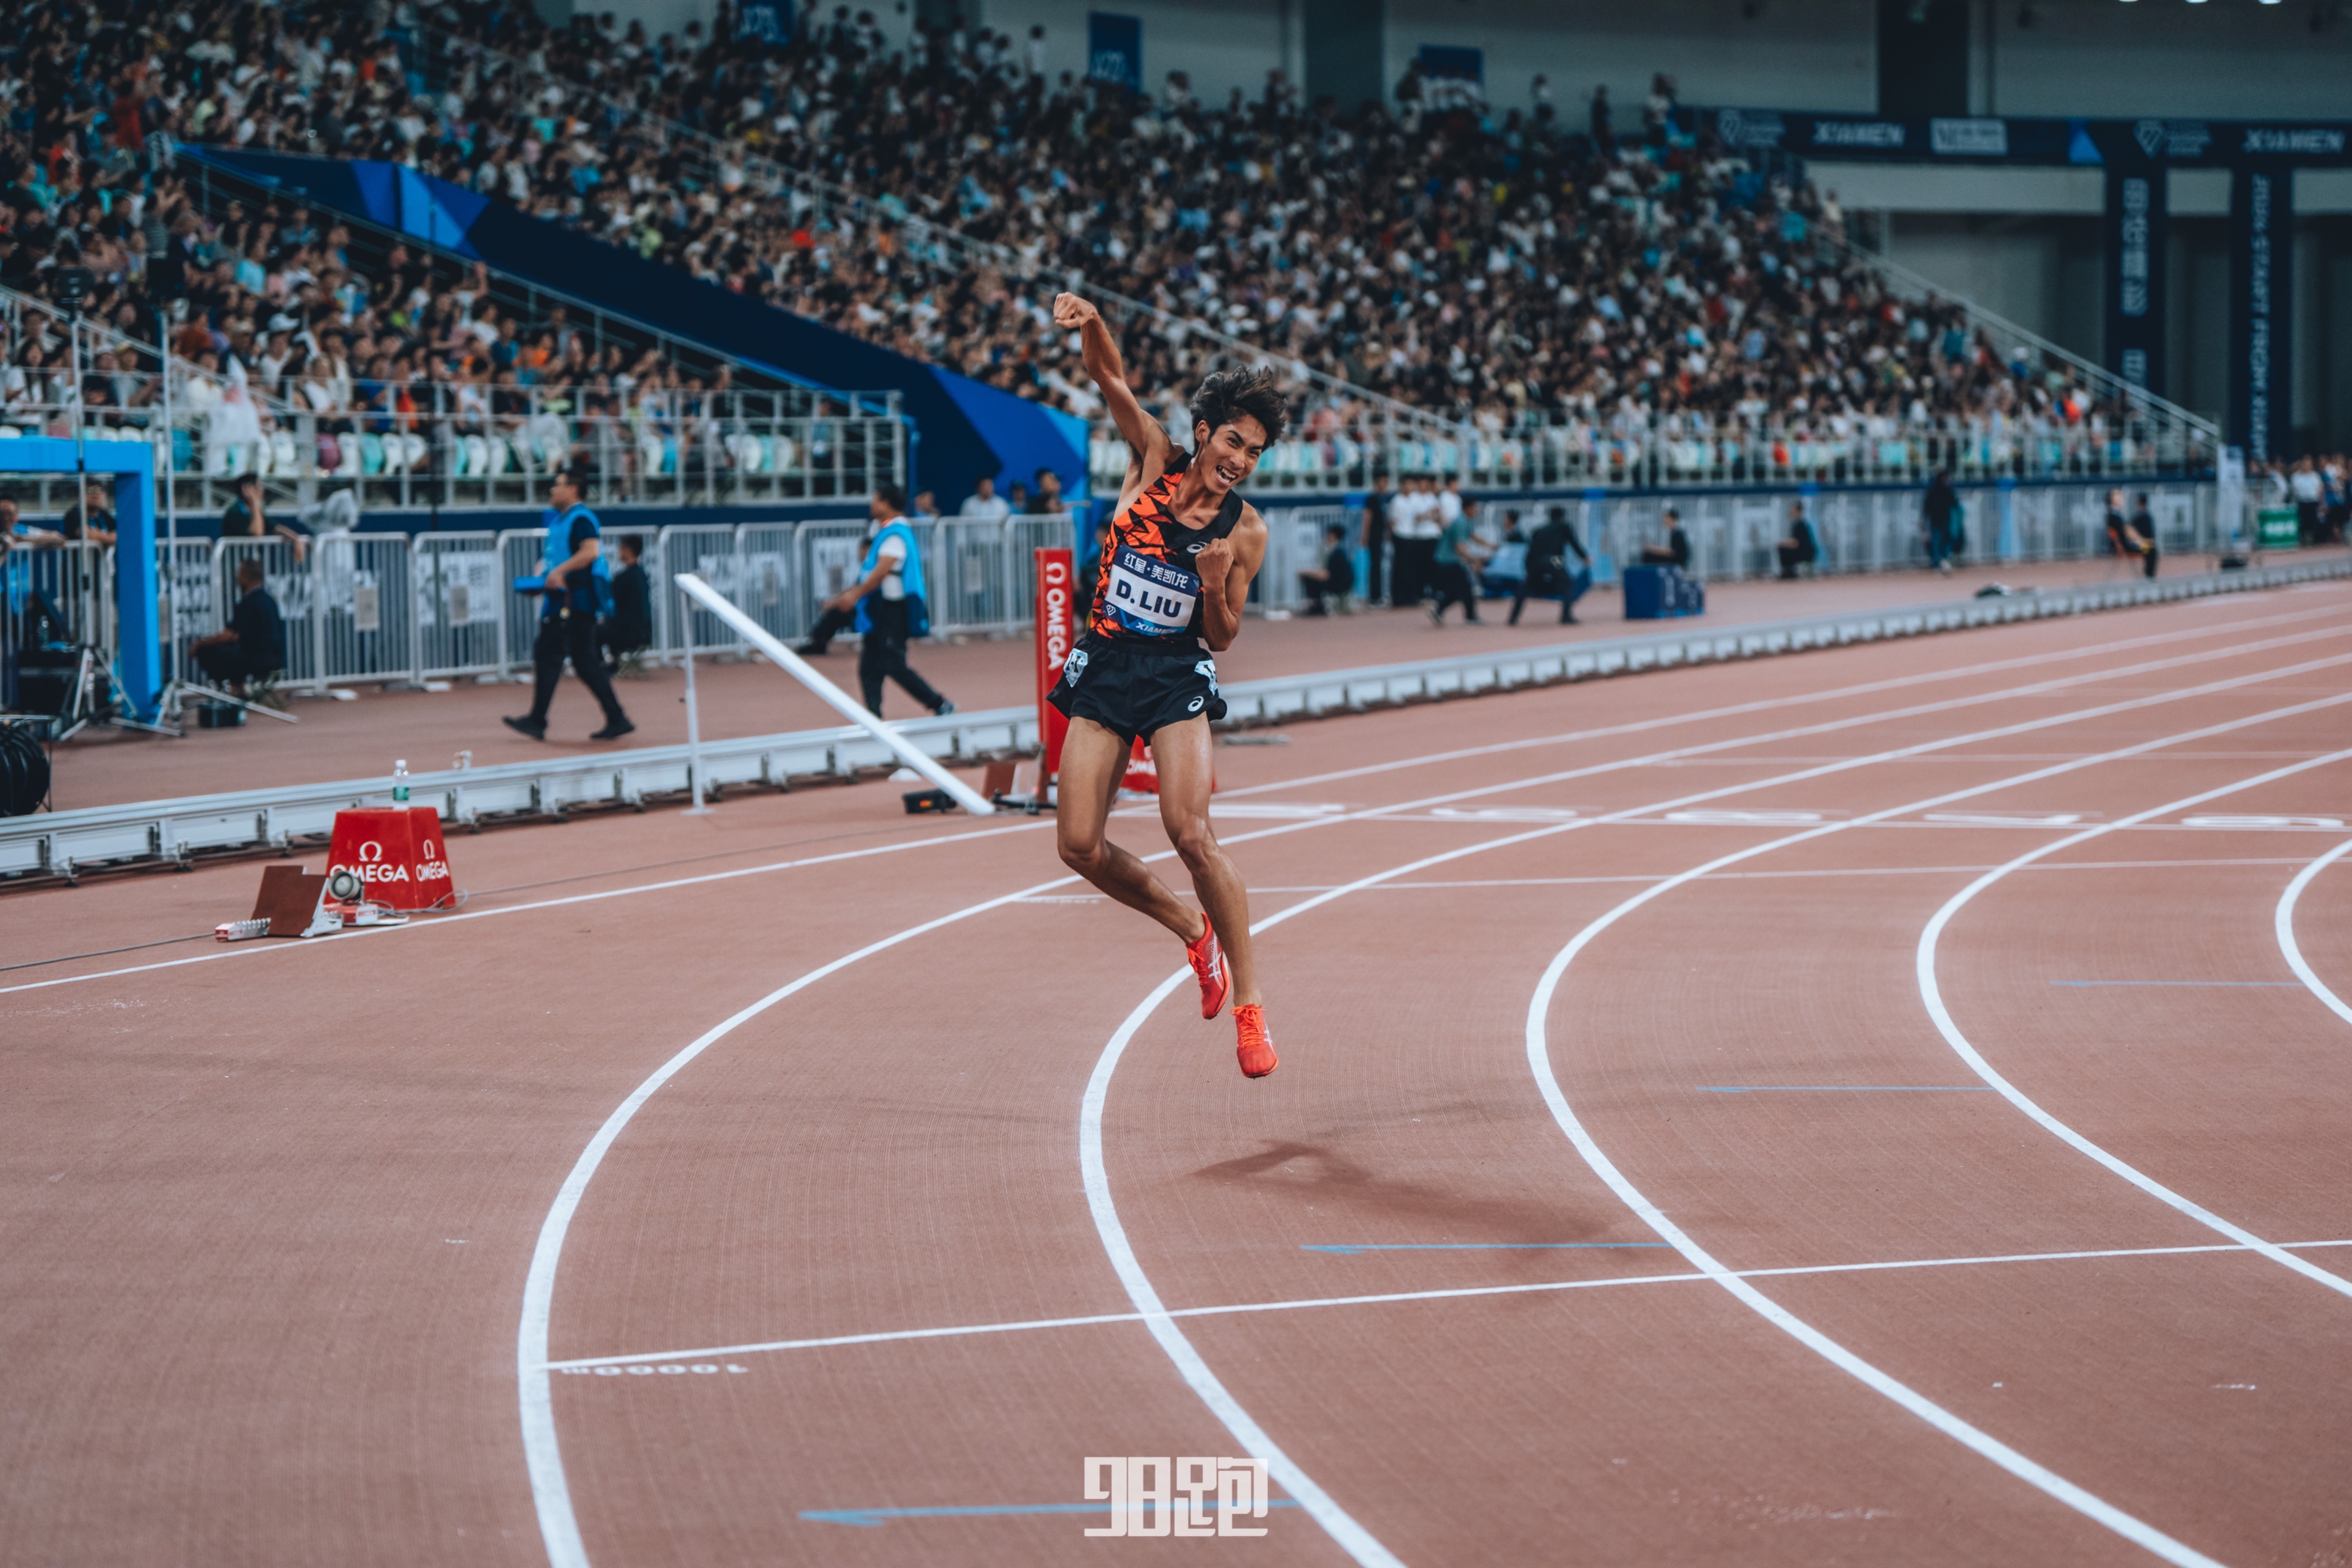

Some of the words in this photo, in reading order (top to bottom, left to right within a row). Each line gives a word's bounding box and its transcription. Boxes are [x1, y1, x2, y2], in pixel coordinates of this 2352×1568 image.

[1124, 552, 1189, 589] 红星·美凯龙
[1046, 588, 1066, 671] OMEGA
[1135, 622, 1177, 633] XIAMEN
[416, 861, 449, 882] OMEGA
